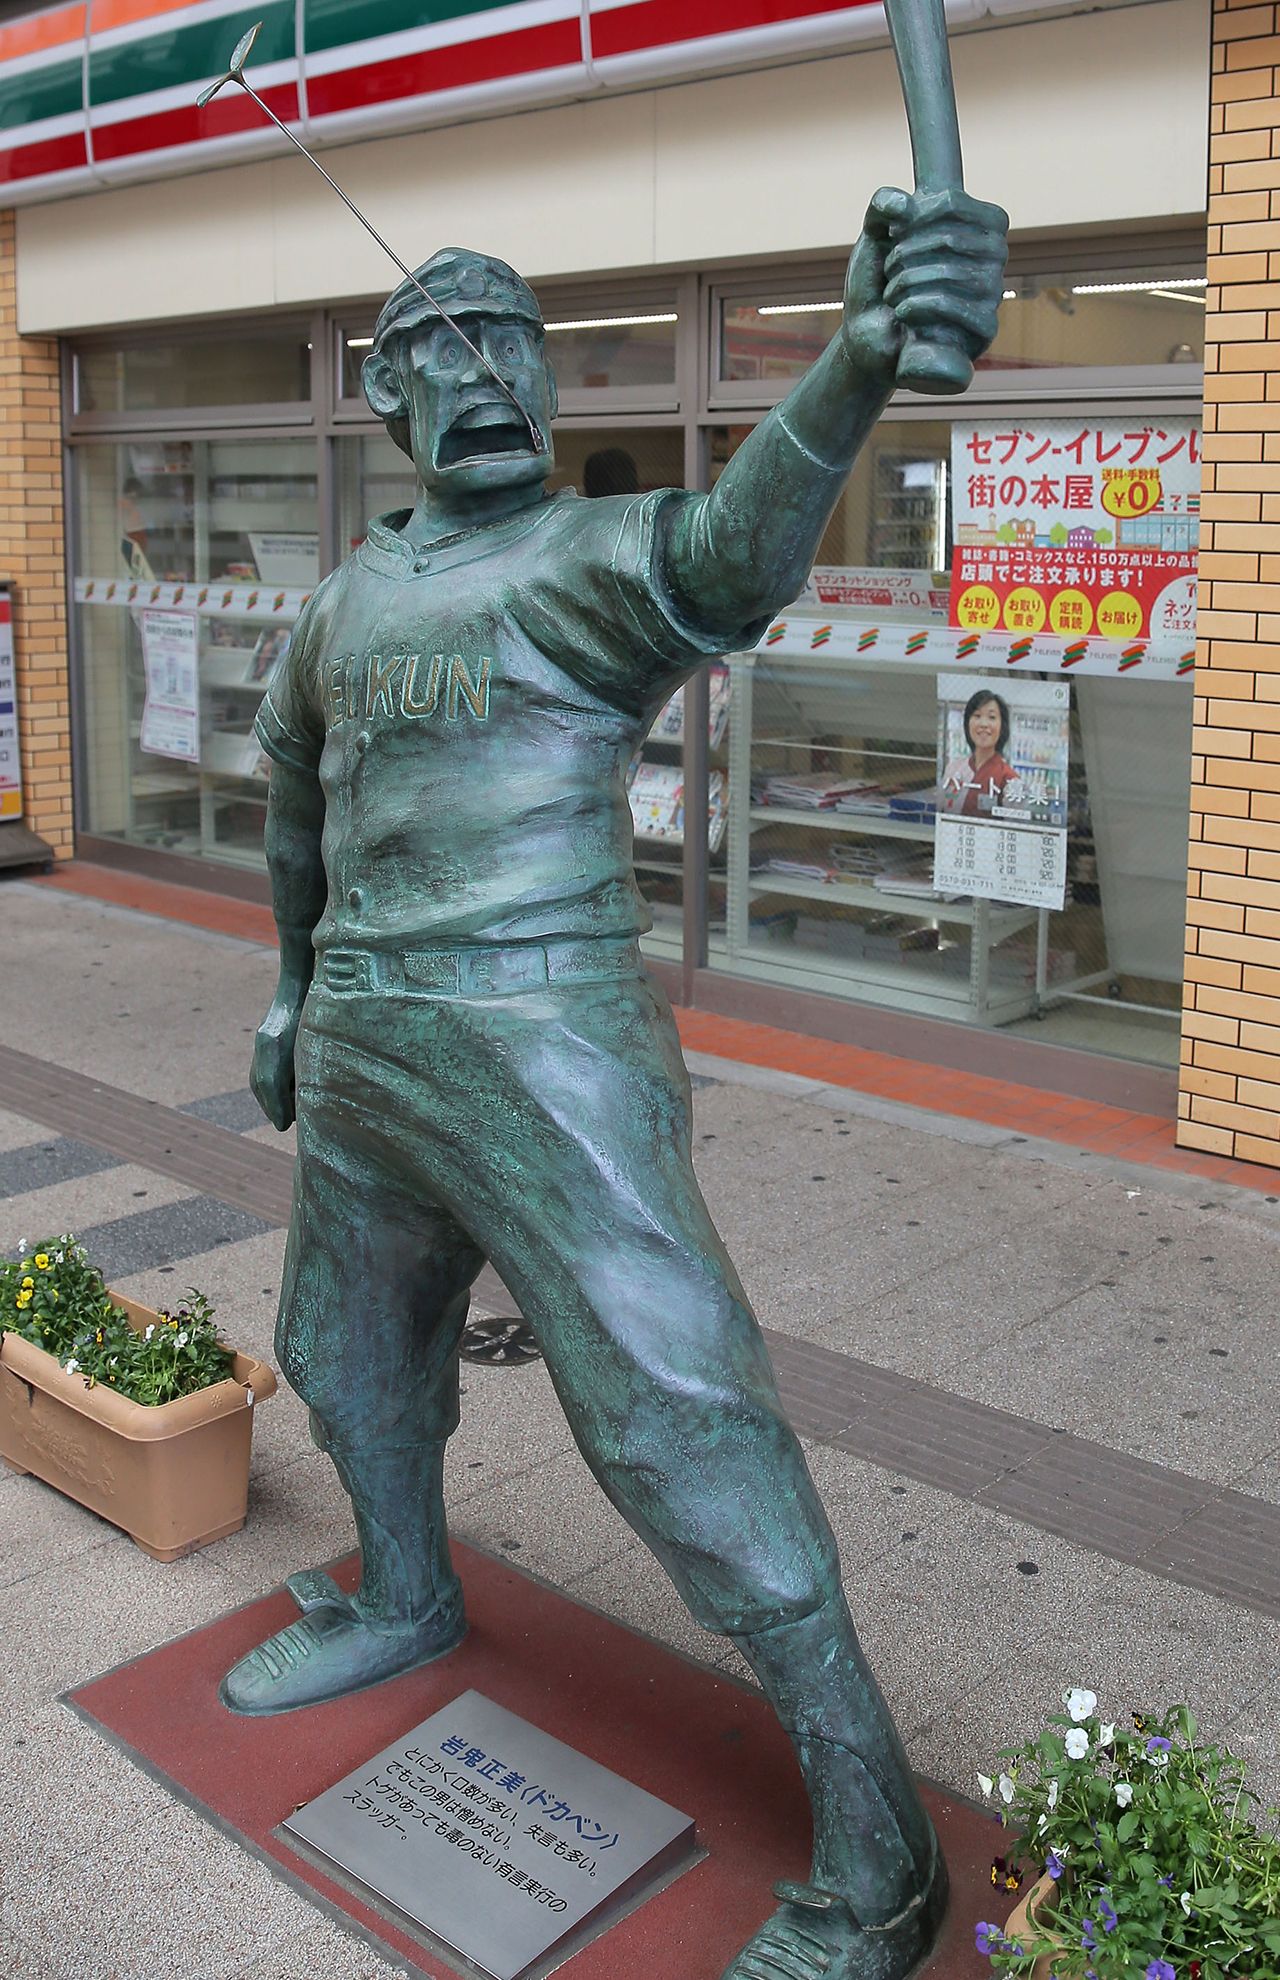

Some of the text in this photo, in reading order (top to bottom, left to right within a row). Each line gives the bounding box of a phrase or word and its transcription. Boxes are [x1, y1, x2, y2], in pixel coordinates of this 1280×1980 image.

[967, 474, 1093, 510] 街の本屋
[963, 595, 995, 610] お取り
[1008, 598, 1041, 612] お取り
[1059, 601, 1083, 614] 定期
[967, 610, 991, 625] 寄せ
[1012, 612, 1035, 627] 置き
[1101, 610, 1138, 626] お届け
[386, 1760, 510, 1851] でもこの男は憎めない。
[342, 1789, 407, 1841] スラッガー。
[365, 1775, 568, 1913] トゲがあっても毒のない有言実行の
